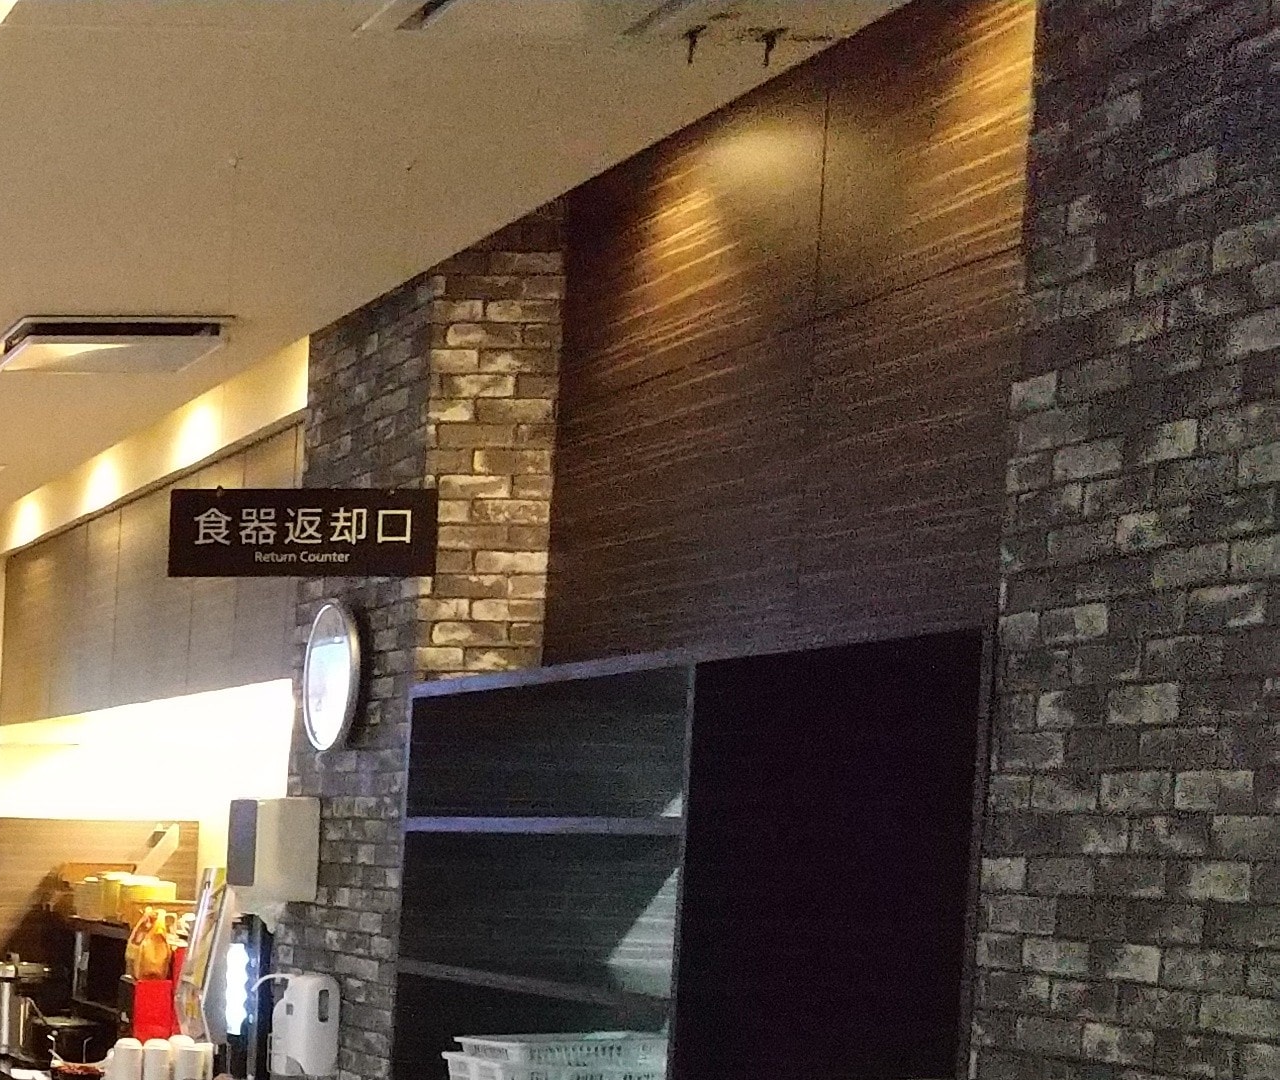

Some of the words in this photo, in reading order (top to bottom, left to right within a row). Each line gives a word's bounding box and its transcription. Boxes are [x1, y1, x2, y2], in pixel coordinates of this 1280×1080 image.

[193, 507, 412, 545] 食器返却口
[254, 551, 297, 563] Return
[300, 550, 351, 563] Counter
